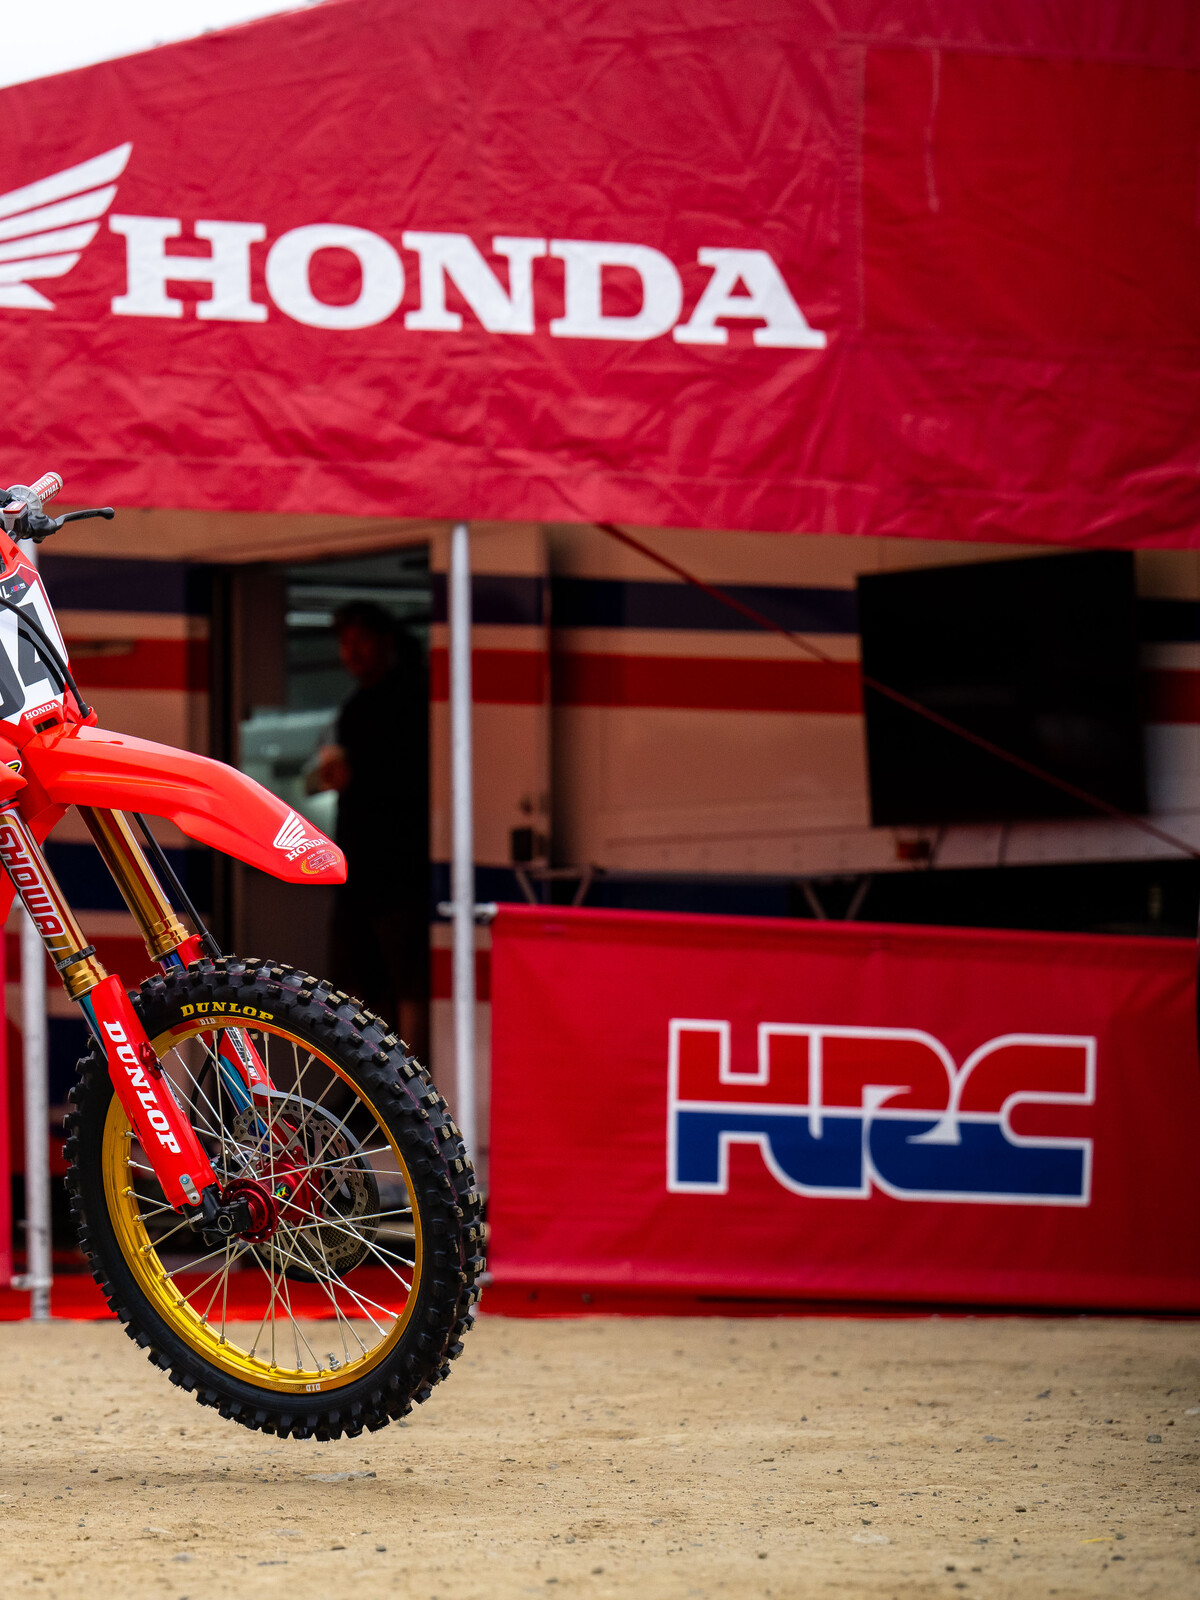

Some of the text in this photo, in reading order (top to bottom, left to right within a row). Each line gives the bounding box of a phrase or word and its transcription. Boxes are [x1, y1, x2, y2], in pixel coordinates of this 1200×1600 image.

[109, 214, 827, 349] HONDA
[24, 701, 59, 721] HONDA
[285, 838, 328, 861] HONDA
[180, 1001, 274, 1020] DUNLOP
[103, 1020, 181, 1153] DUNLOP
[667, 1018, 1097, 1207] HRC
